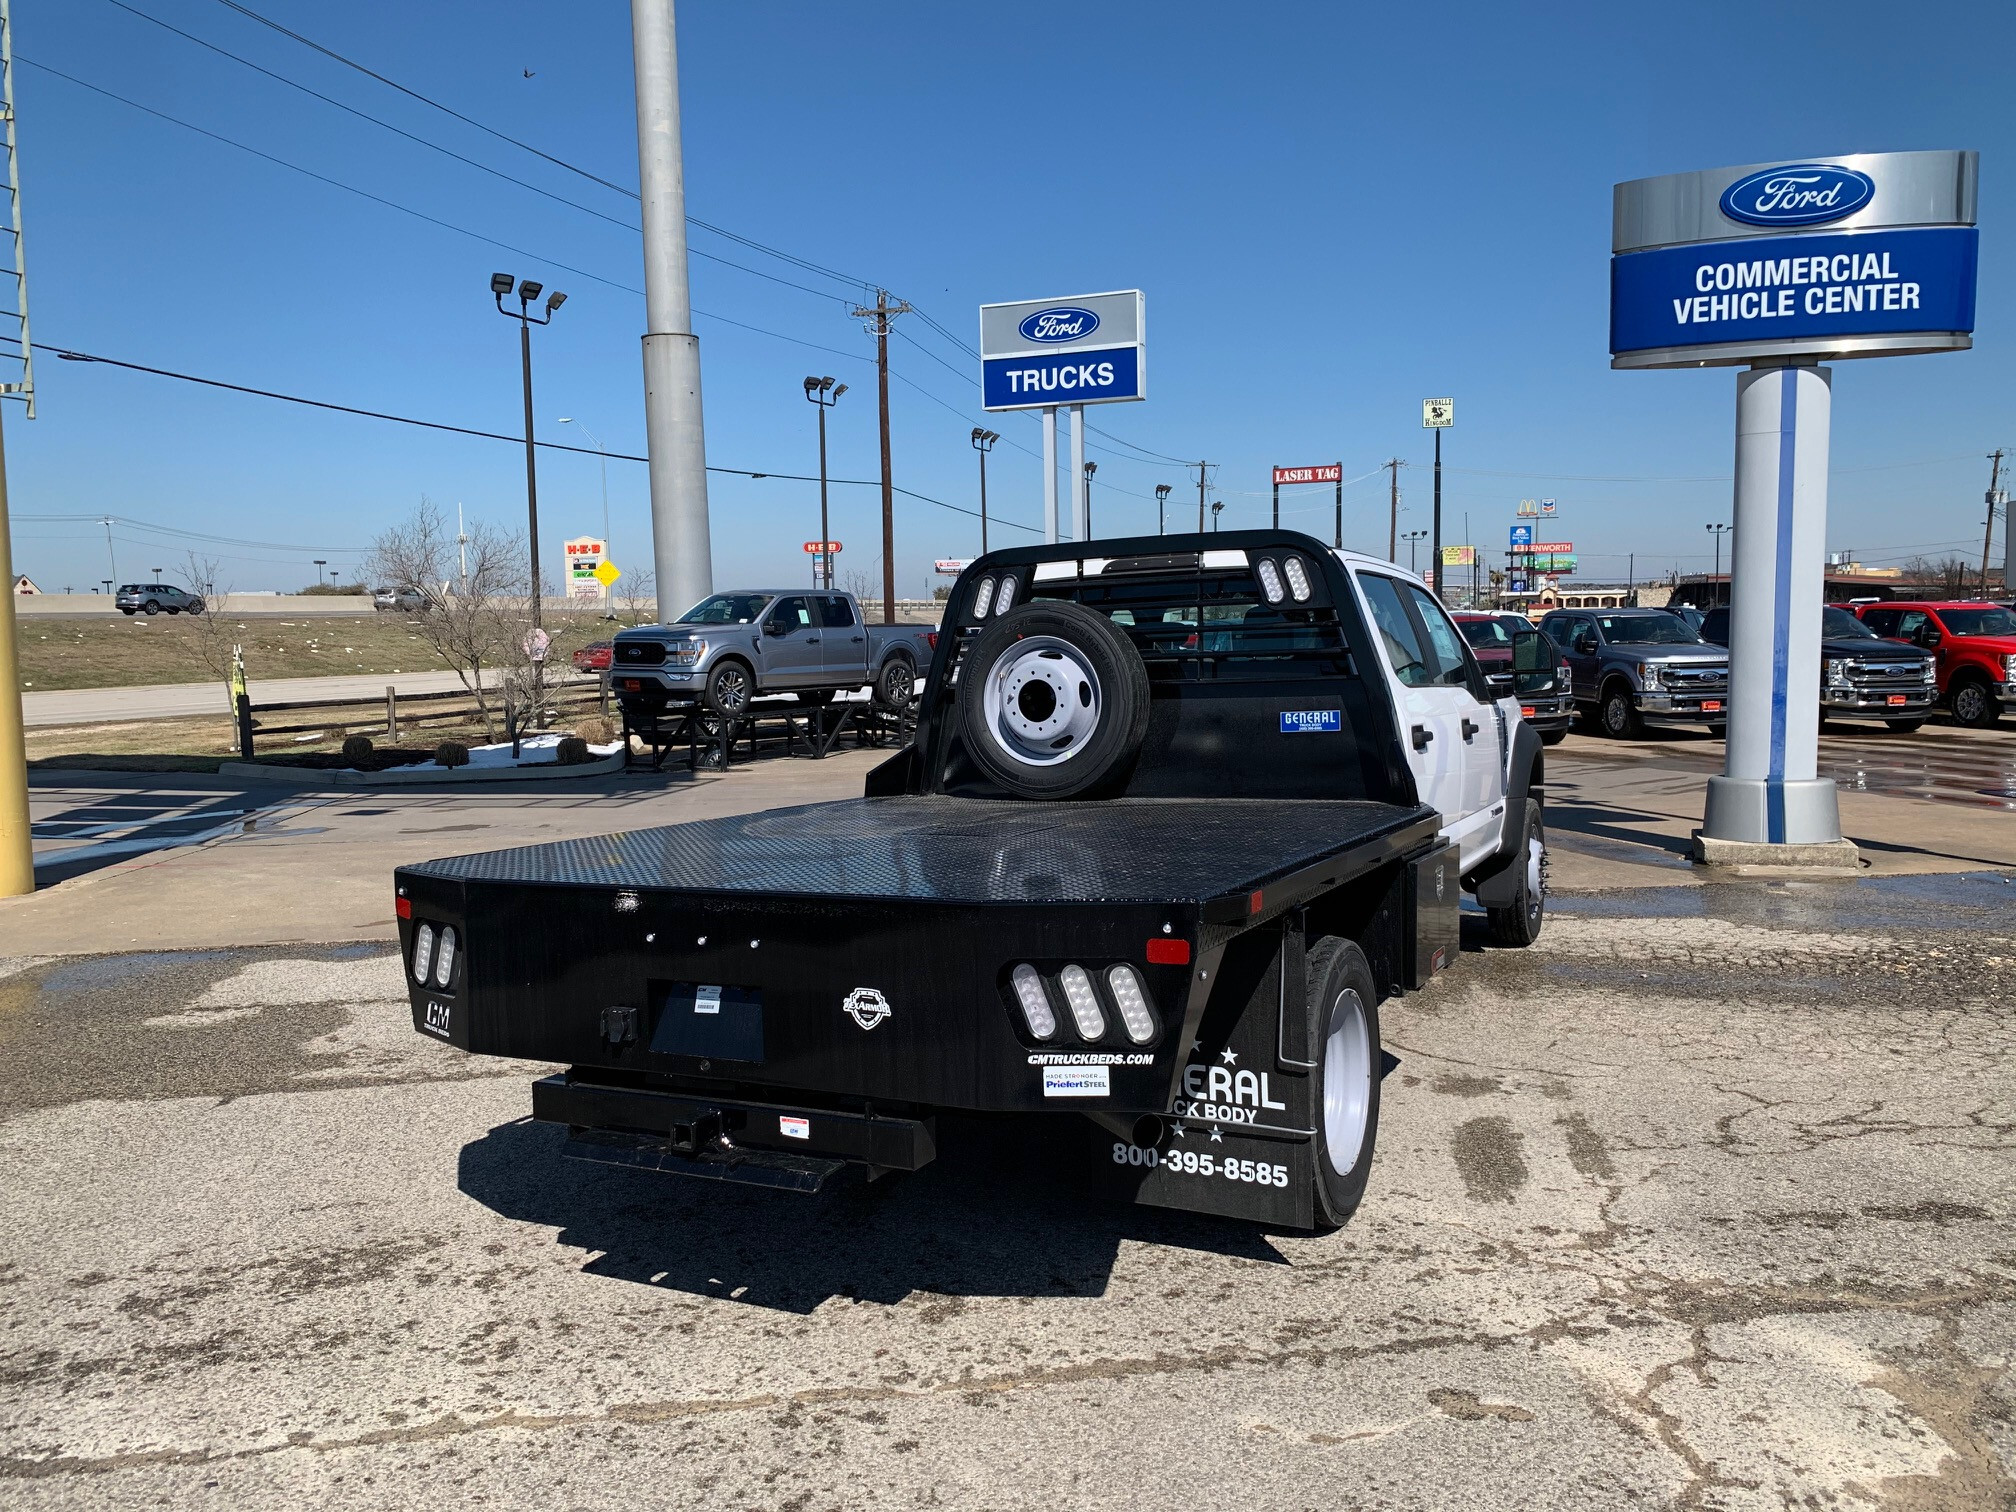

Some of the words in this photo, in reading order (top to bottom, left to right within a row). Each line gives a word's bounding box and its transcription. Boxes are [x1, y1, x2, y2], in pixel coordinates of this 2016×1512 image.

[1755, 176, 1843, 212] Ford
[1695, 252, 1899, 292] COMMERCIAL
[1673, 289, 1795, 324] VEHICLE
[1804, 282, 1921, 315] CENTER
[1034, 314, 1083, 338] Ford
[1006, 362, 1115, 393] TRUCKS
[1425, 418, 1452, 427] KINGDOM
[1275, 469, 1313, 482] LASER
[1316, 467, 1339, 480] TAG
[1285, 711, 1336, 723] GENERAL
[427, 1001, 450, 1030] CM
[1027, 1054, 1154, 1065] CMTRUCKBEDS.COM
[1176, 1063, 1286, 1111] ERAL
[1204, 1103, 1258, 1124] BODY
[1112, 1142, 1289, 1188] 800-395-8585
